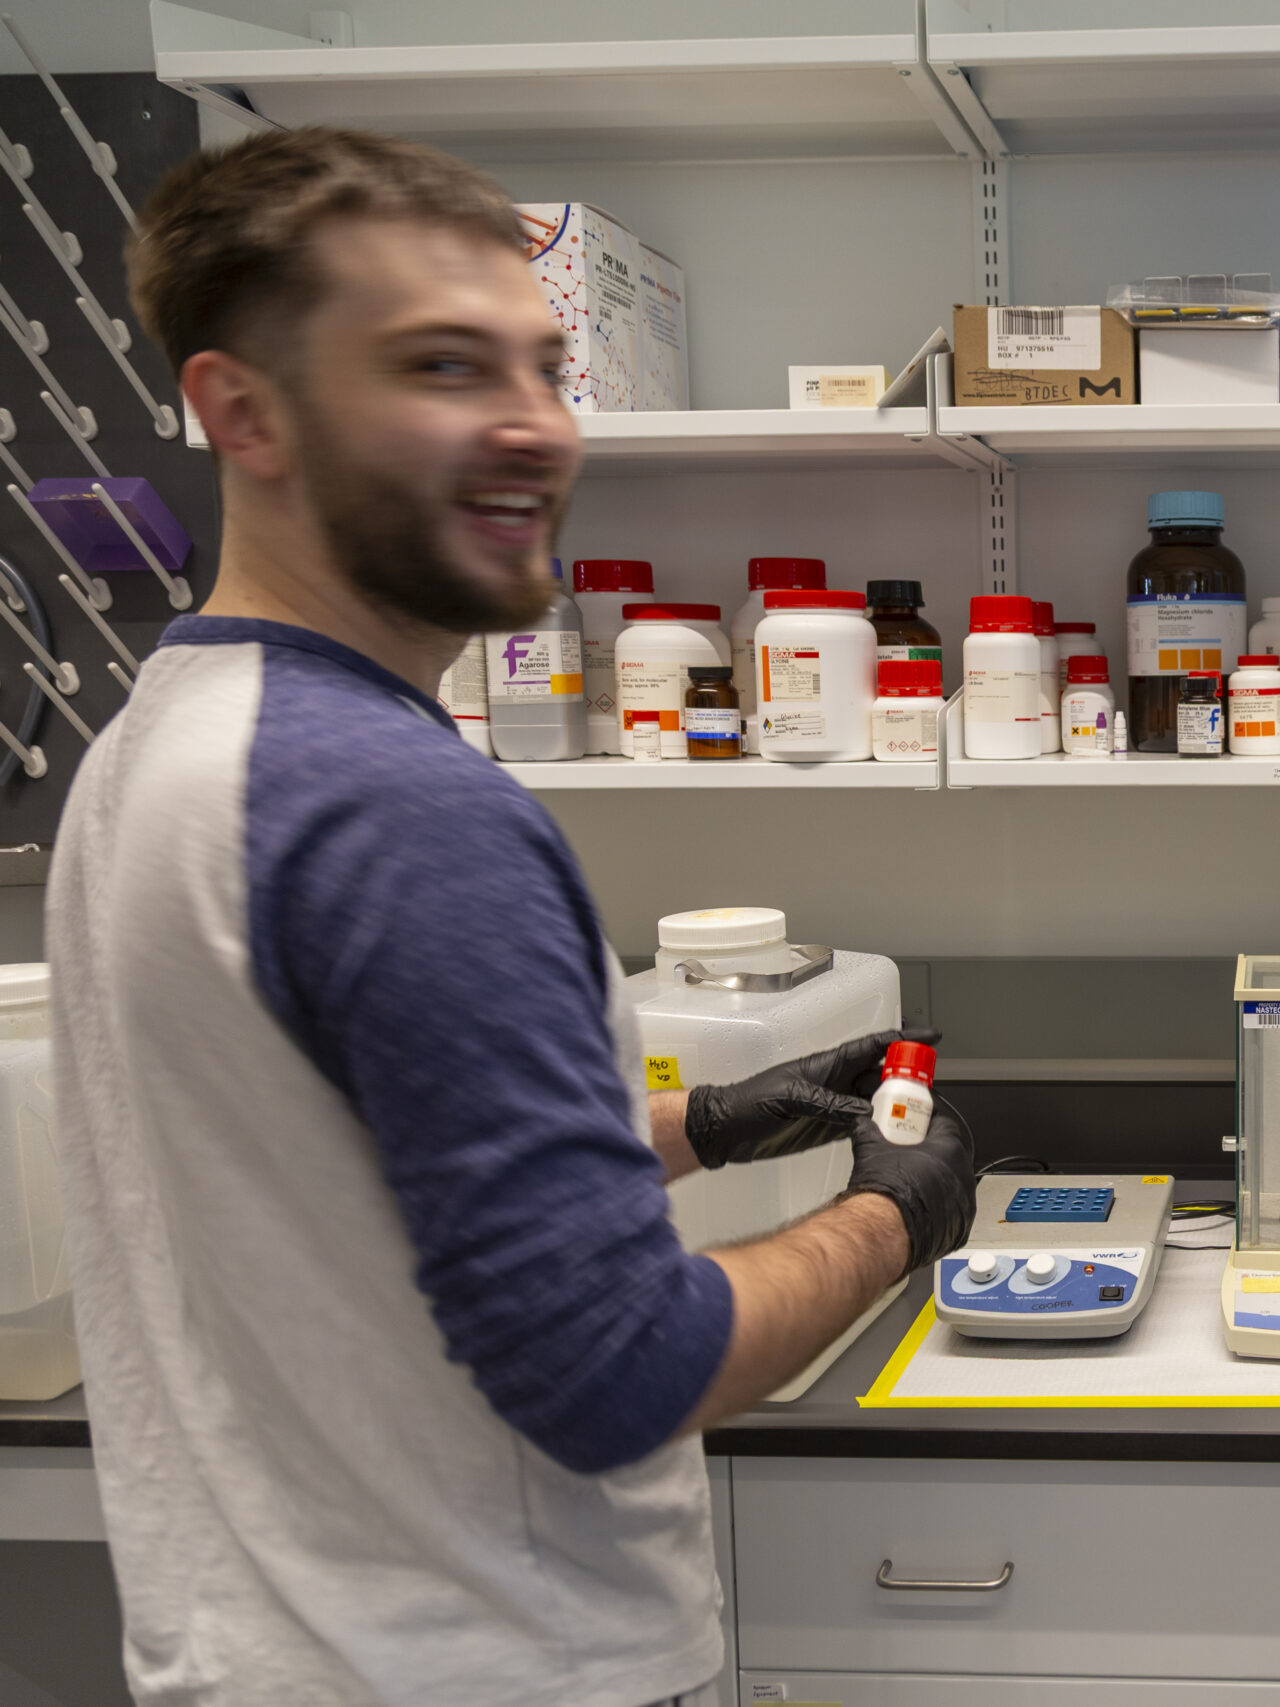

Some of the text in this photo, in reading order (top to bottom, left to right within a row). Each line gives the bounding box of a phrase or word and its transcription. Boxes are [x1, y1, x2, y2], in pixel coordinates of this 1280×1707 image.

[518, 661, 550, 669] Agarose
[1233, 688, 1259, 697] SIGMA
[1031, 1301, 1074, 1311] COOPER
